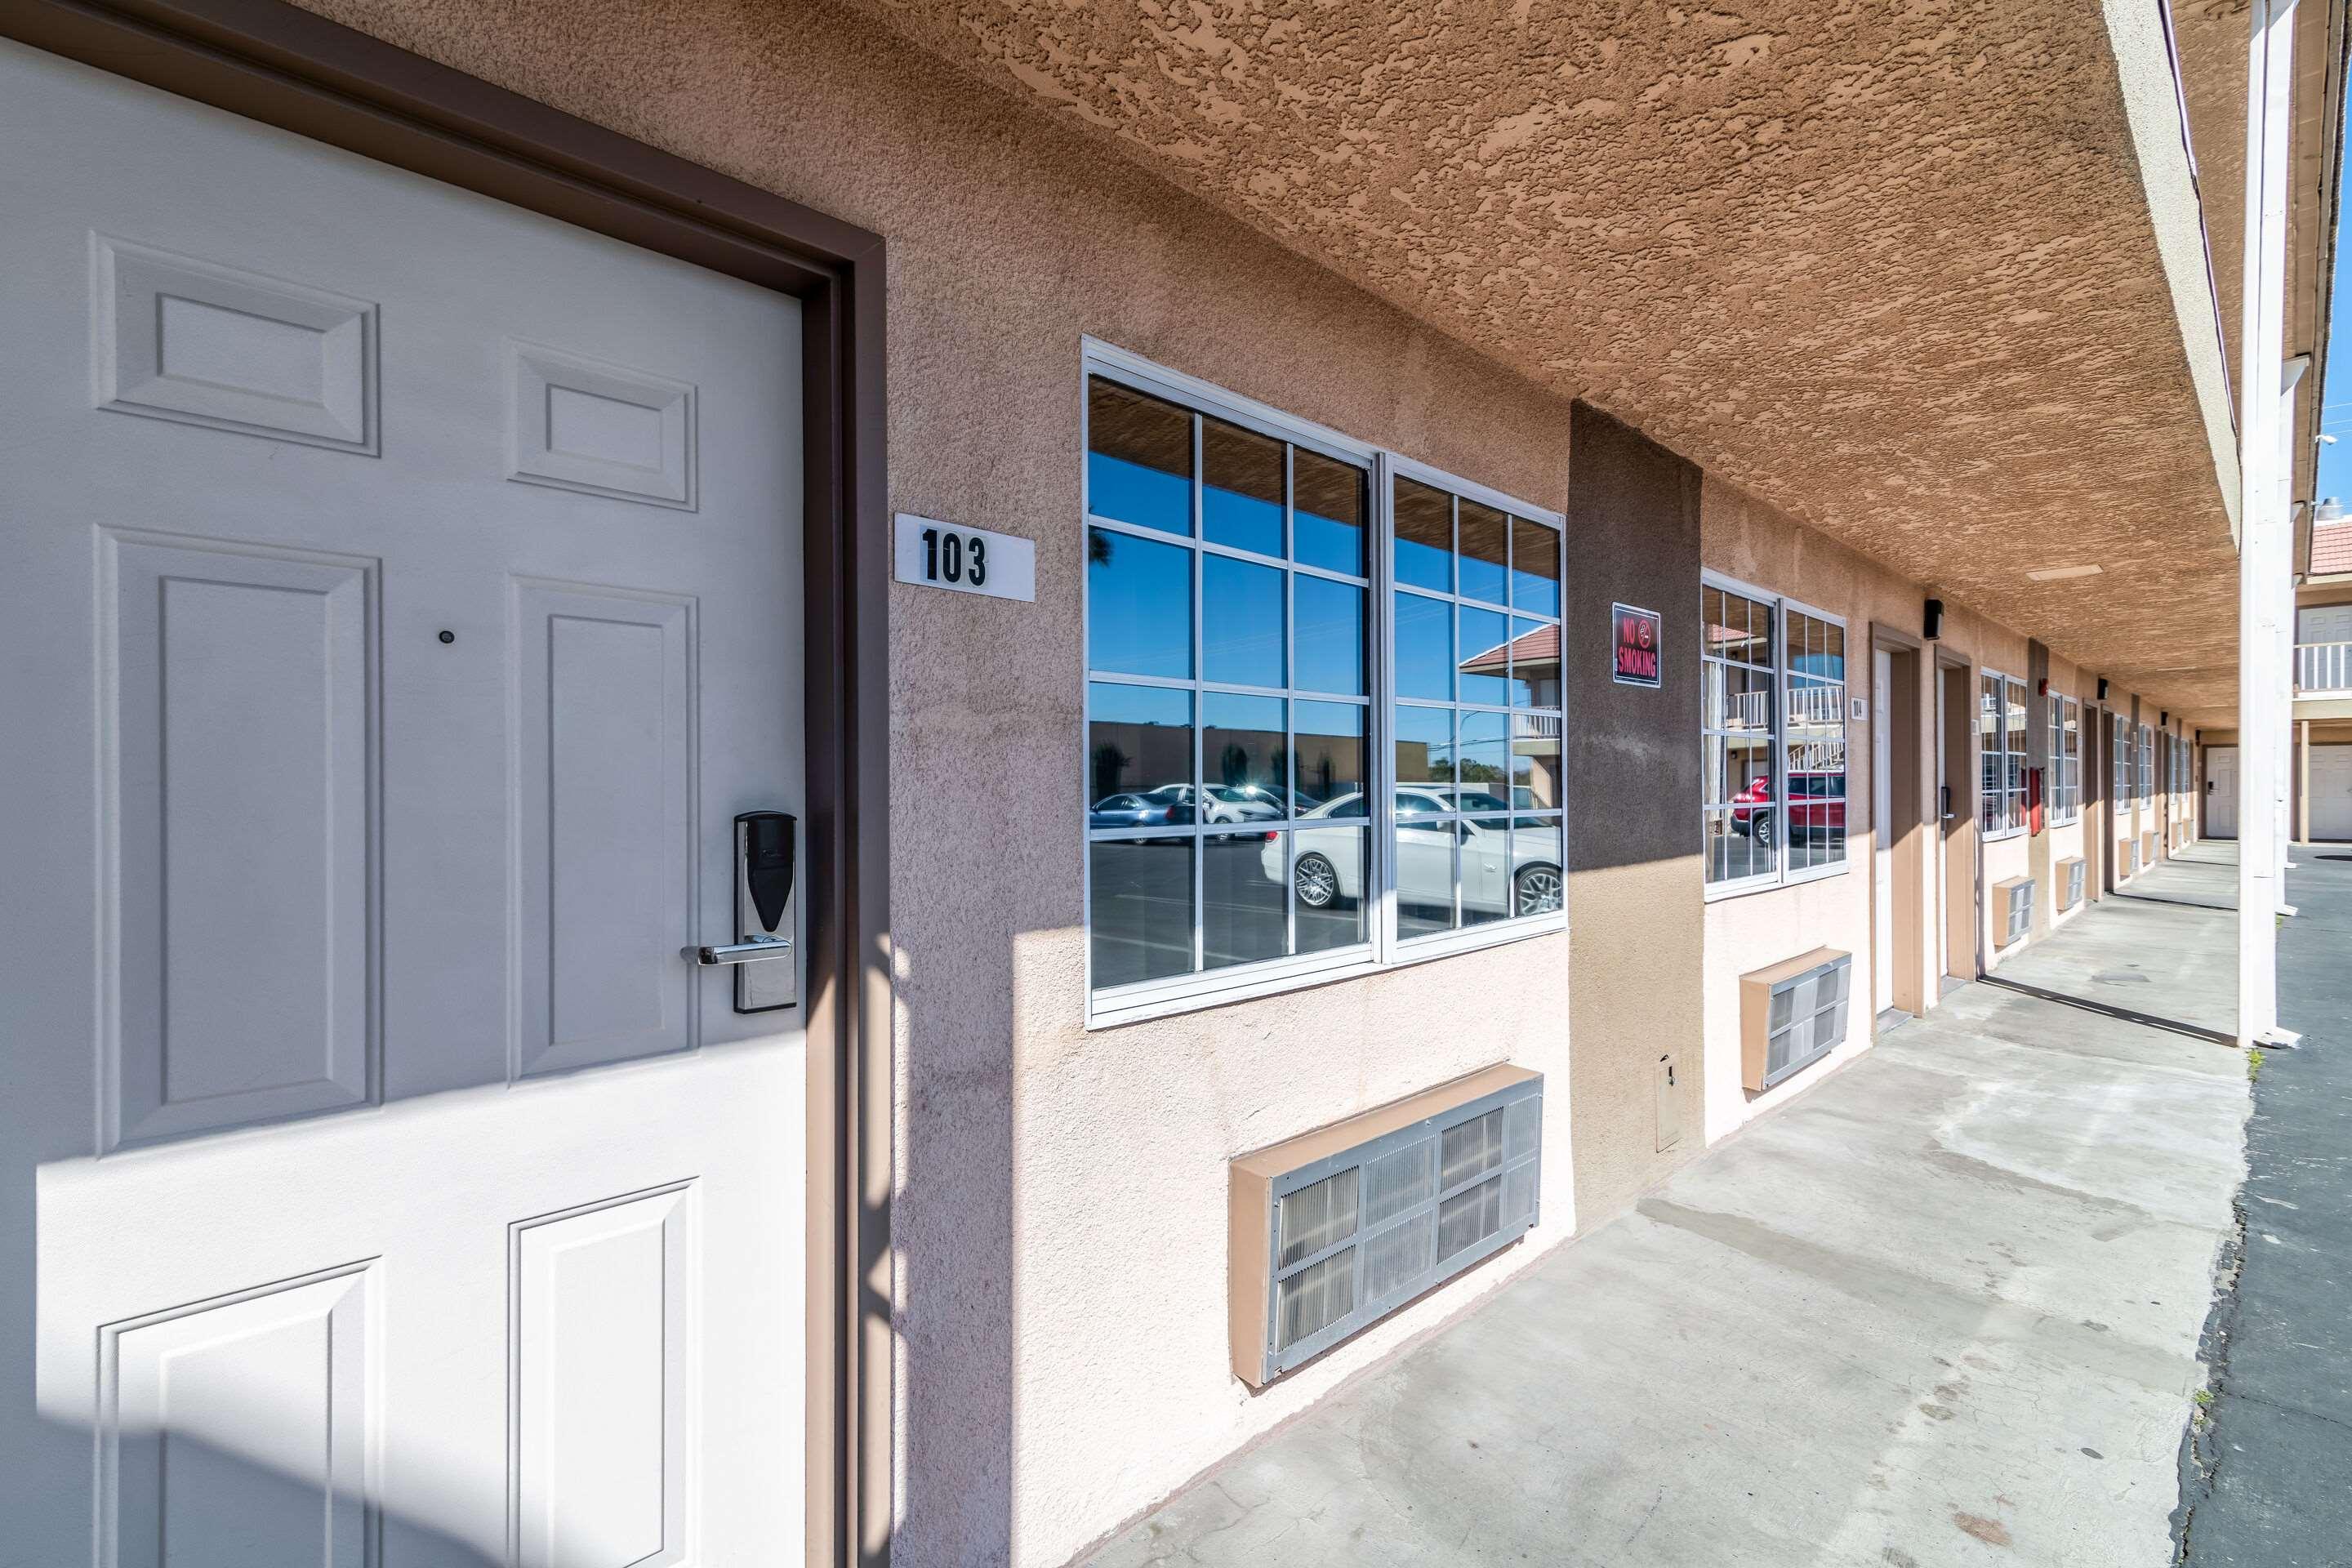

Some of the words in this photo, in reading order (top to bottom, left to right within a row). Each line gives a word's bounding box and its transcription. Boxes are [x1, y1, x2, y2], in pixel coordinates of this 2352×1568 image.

[922, 528, 986, 586] 103
[1623, 617, 1636, 645] NO
[1619, 646, 1656, 677] SMOKING
